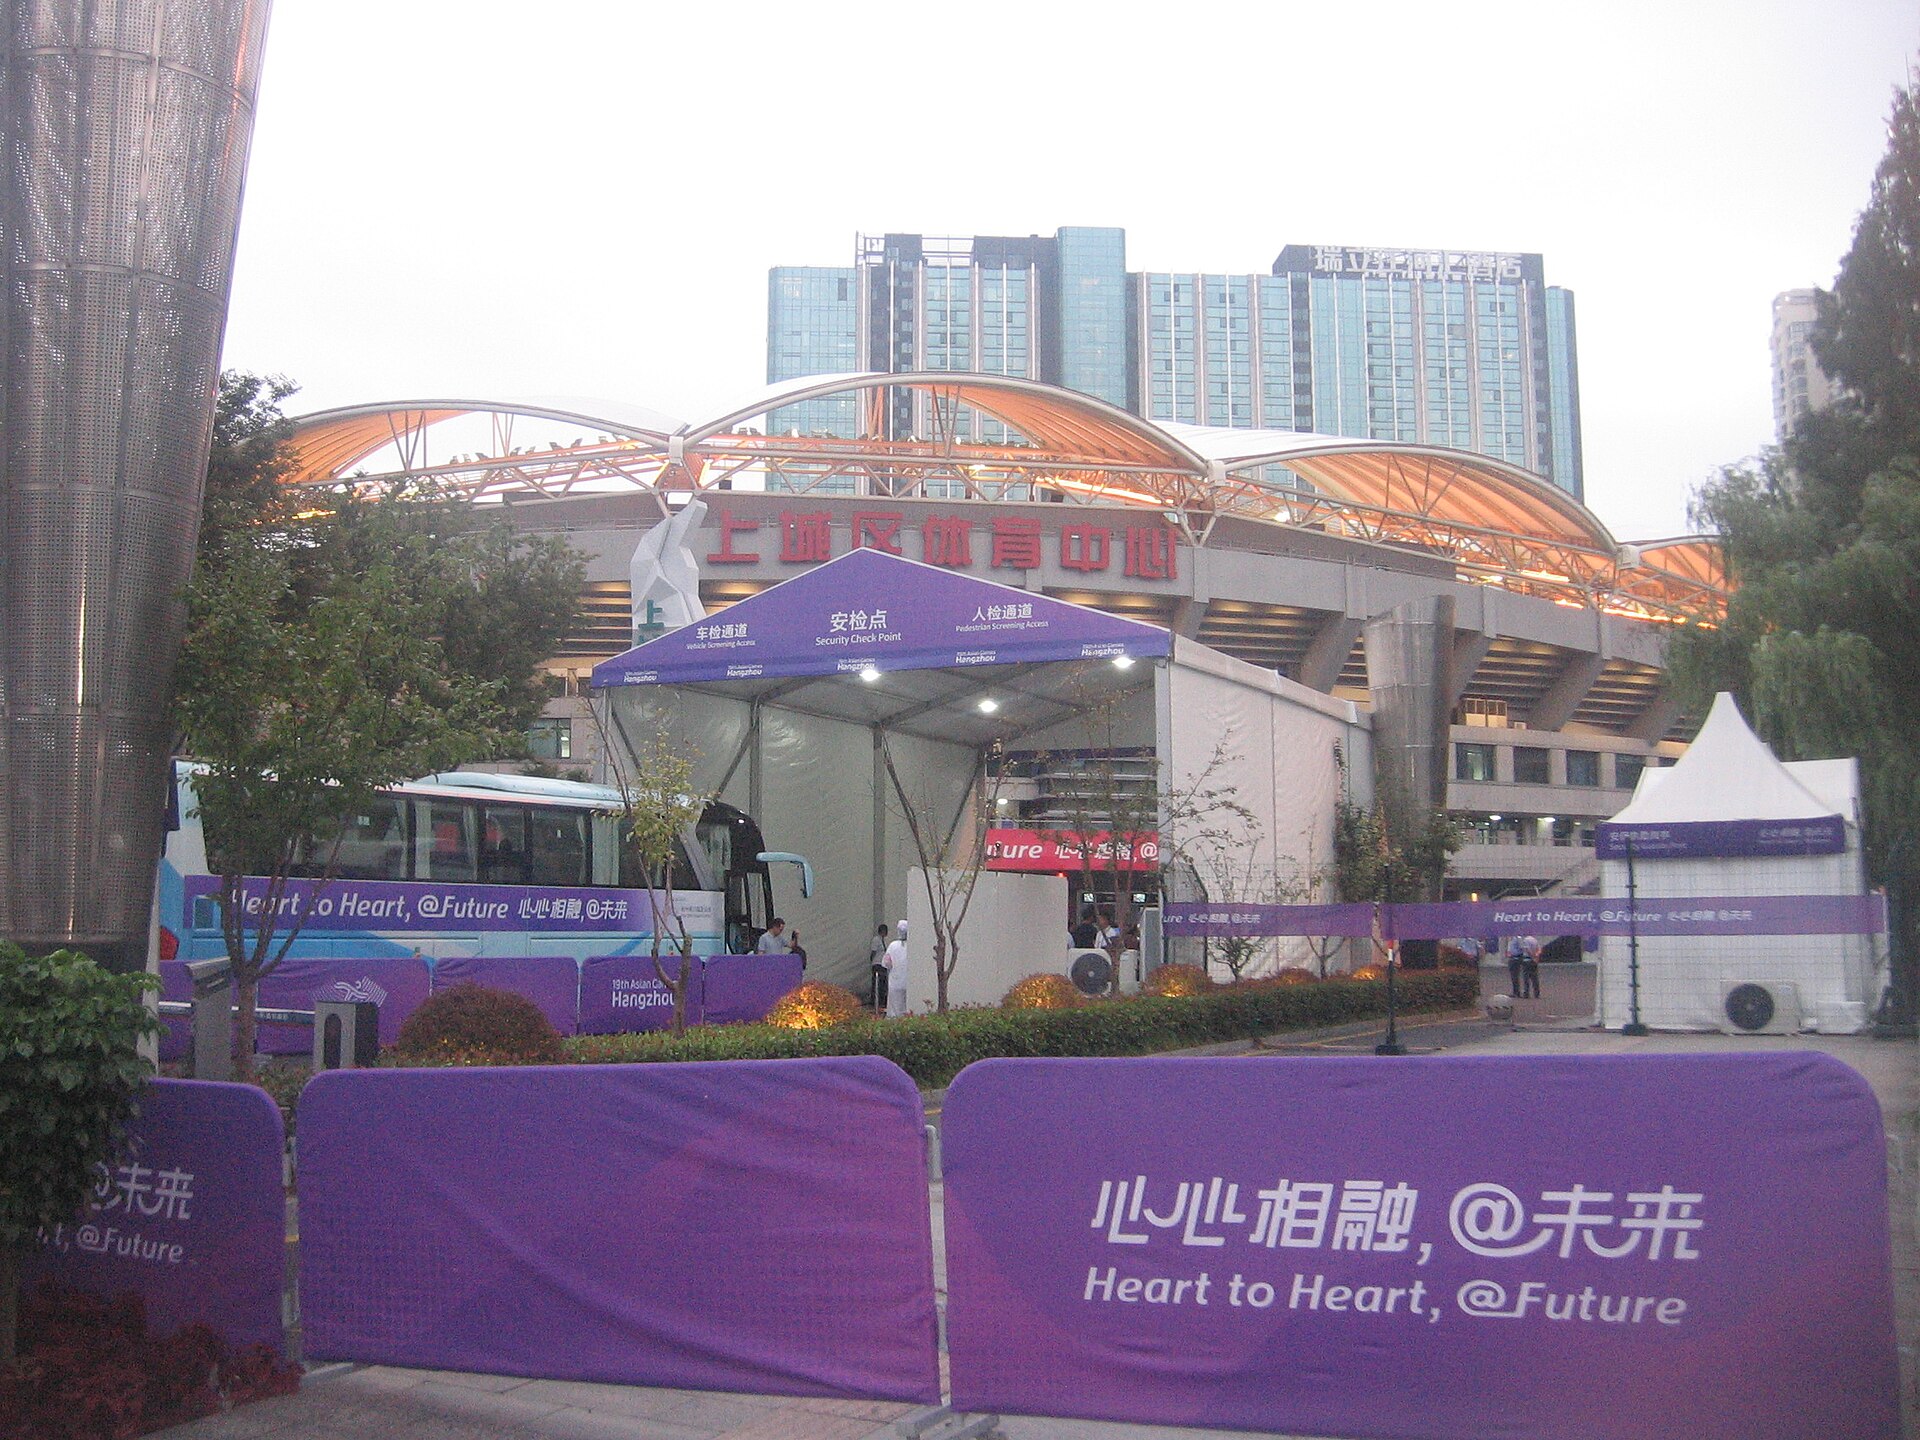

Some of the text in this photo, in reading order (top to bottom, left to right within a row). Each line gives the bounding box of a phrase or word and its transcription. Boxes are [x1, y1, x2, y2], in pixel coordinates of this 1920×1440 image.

[707, 509, 1177, 579] 上城区体育中心
[829, 608, 887, 633] 安检点
[972, 603, 1033, 621] 人检通道
[696, 623, 748, 641] 车检通道
[955, 623, 991, 632] Pedestrian
[991, 622, 1025, 631] Screening
[815, 631, 902, 647] Security Check Point
[837, 662, 875, 672] Hangzhou
[955, 654, 996, 664] Hangzhou
[726, 668, 762, 677] Hangzhou
[309, 892, 333, 917] o
[339, 892, 410, 923] Heart,
[417, 893, 508, 921] @Future
[1494, 912, 1532, 922] Heart
[1537, 912, 1551, 922] to
[1600, 910, 1662, 923] @Future
[612, 979, 629, 989] 19th
[630, 979, 651, 989] Asian
[612, 990, 675, 1010] Hangzhou
[76, 1223, 185, 1264] @Future
[1083, 1266, 1688, 1326] Heart to Heart, @Future
